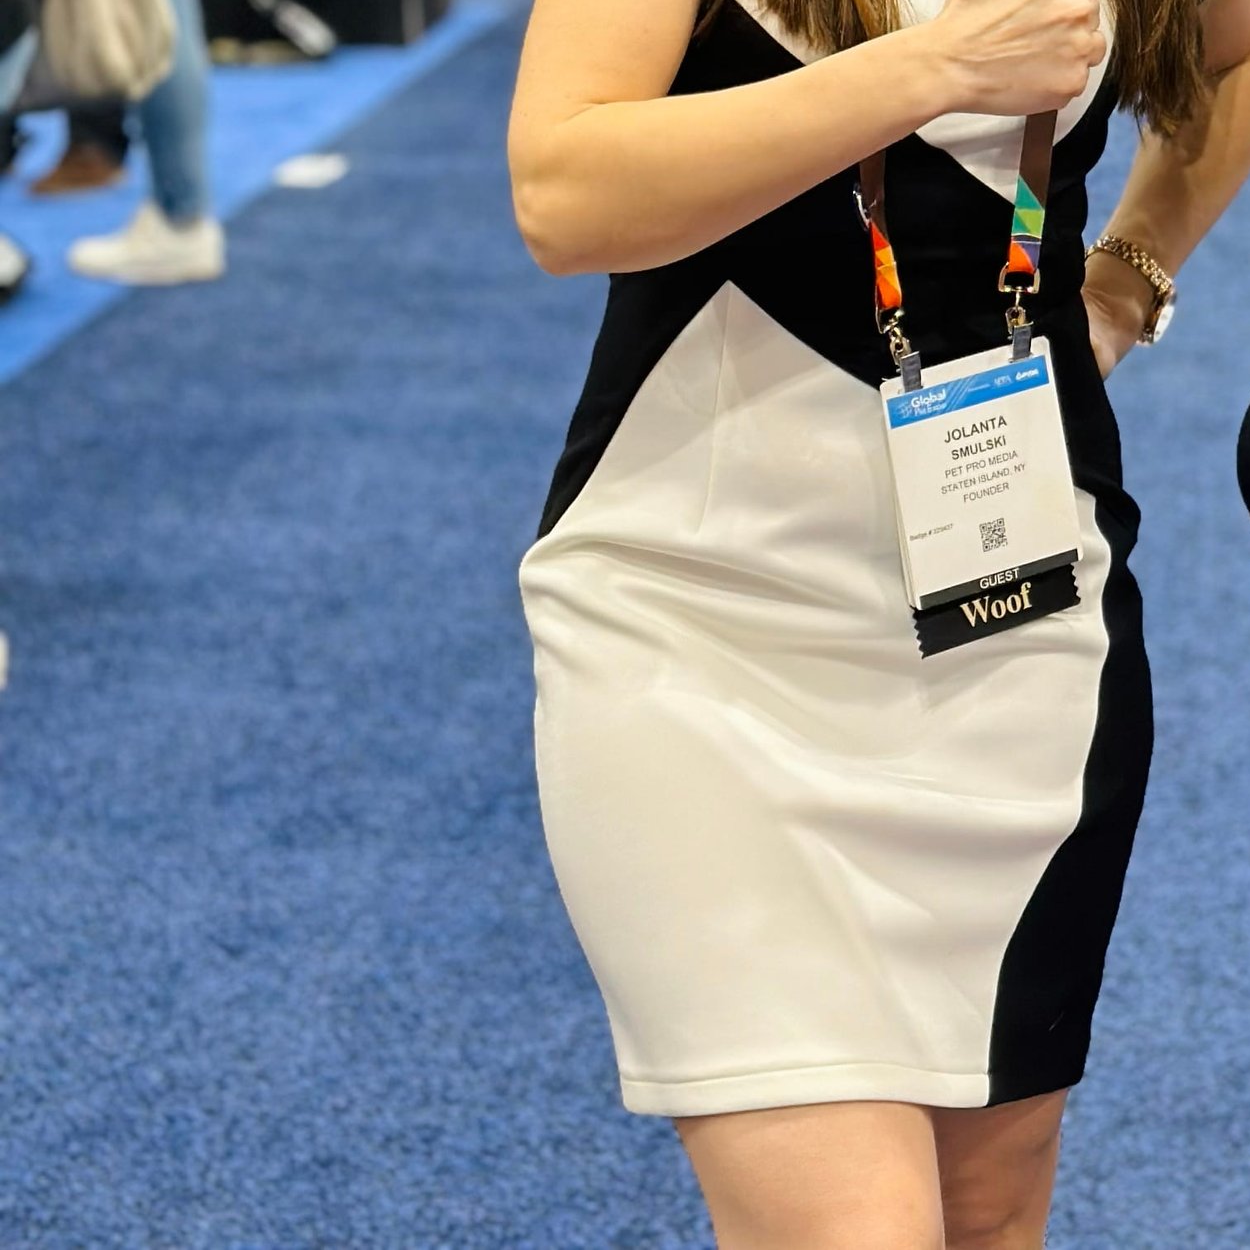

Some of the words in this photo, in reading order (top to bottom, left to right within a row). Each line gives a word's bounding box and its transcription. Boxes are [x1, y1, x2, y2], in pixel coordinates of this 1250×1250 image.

[911, 389, 947, 408] Global
[944, 415, 1008, 443] JOLANTA
[951, 435, 1007, 460] SMULSKI
[944, 466, 963, 478] PET
[966, 460, 987, 472] PRO
[988, 450, 1018, 465] MEDIA
[941, 478, 976, 495] STATEN
[1014, 463, 1025, 472] NY
[963, 482, 1010, 503] FOUNDER
[980, 568, 1019, 589] GUEST
[959, 581, 1033, 628] Woof
